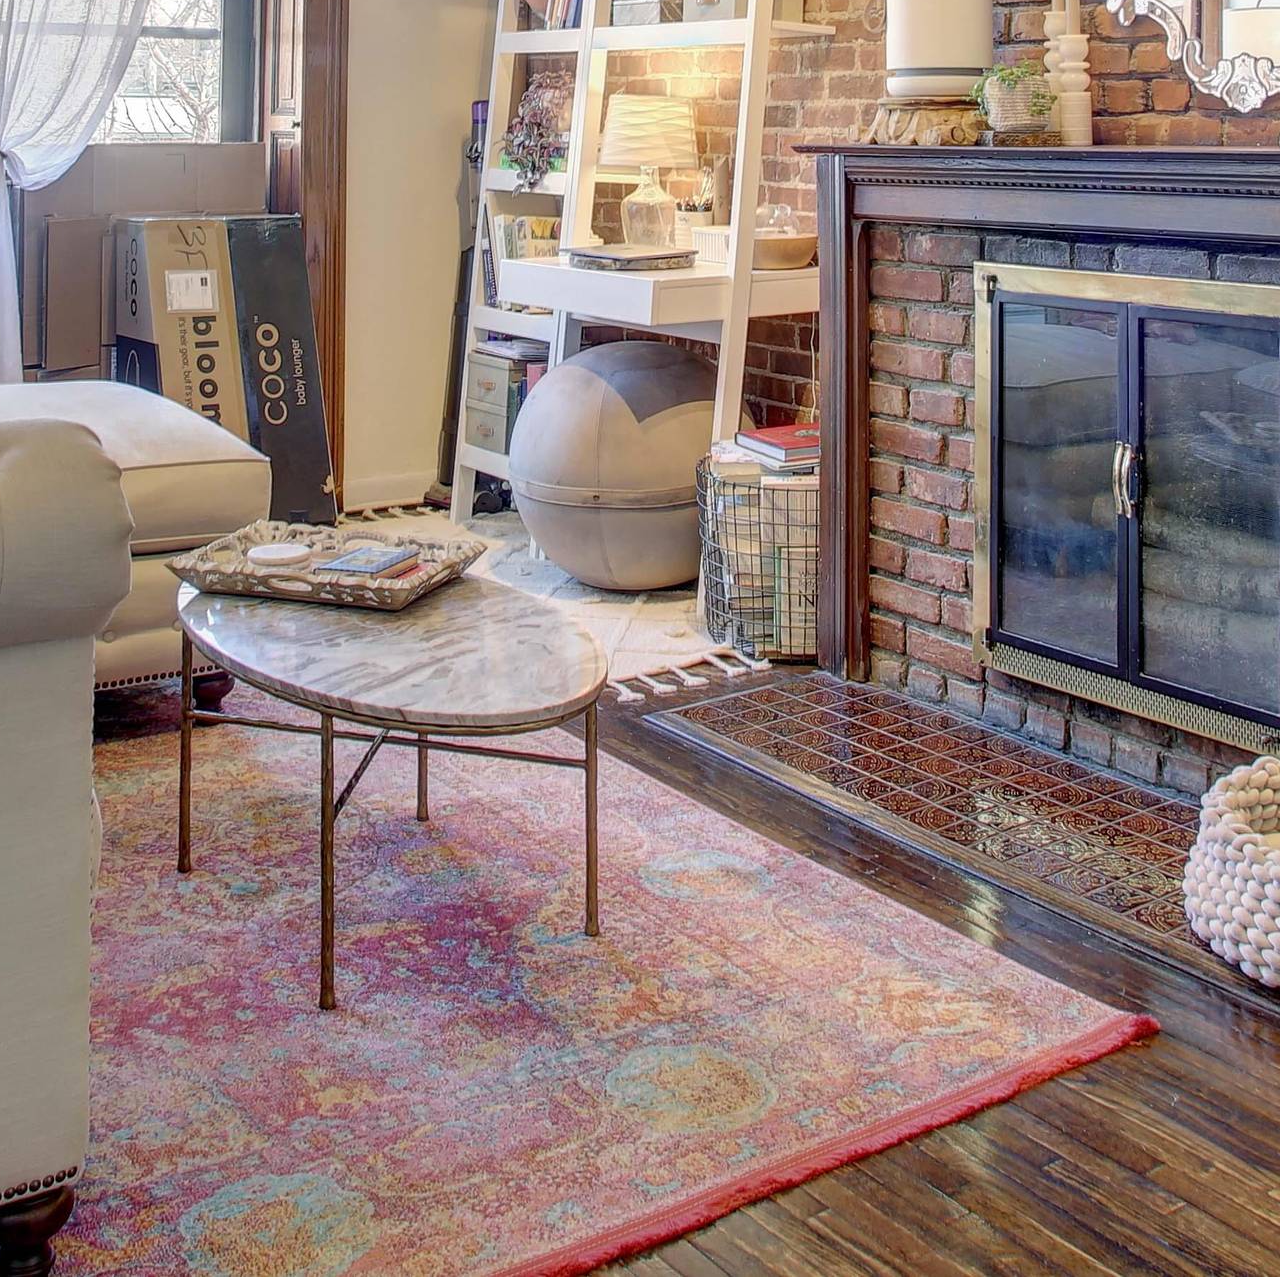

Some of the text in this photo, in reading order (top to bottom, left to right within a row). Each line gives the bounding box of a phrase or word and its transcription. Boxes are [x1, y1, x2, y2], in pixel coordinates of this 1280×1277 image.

[130, 237, 138, 318] COCO
[179, 329, 188, 347] their
[179, 348, 191, 370] gear,
[183, 371, 192, 384] but
[256, 323, 288, 425] COCO
[291, 339, 306, 406] baby lounger
